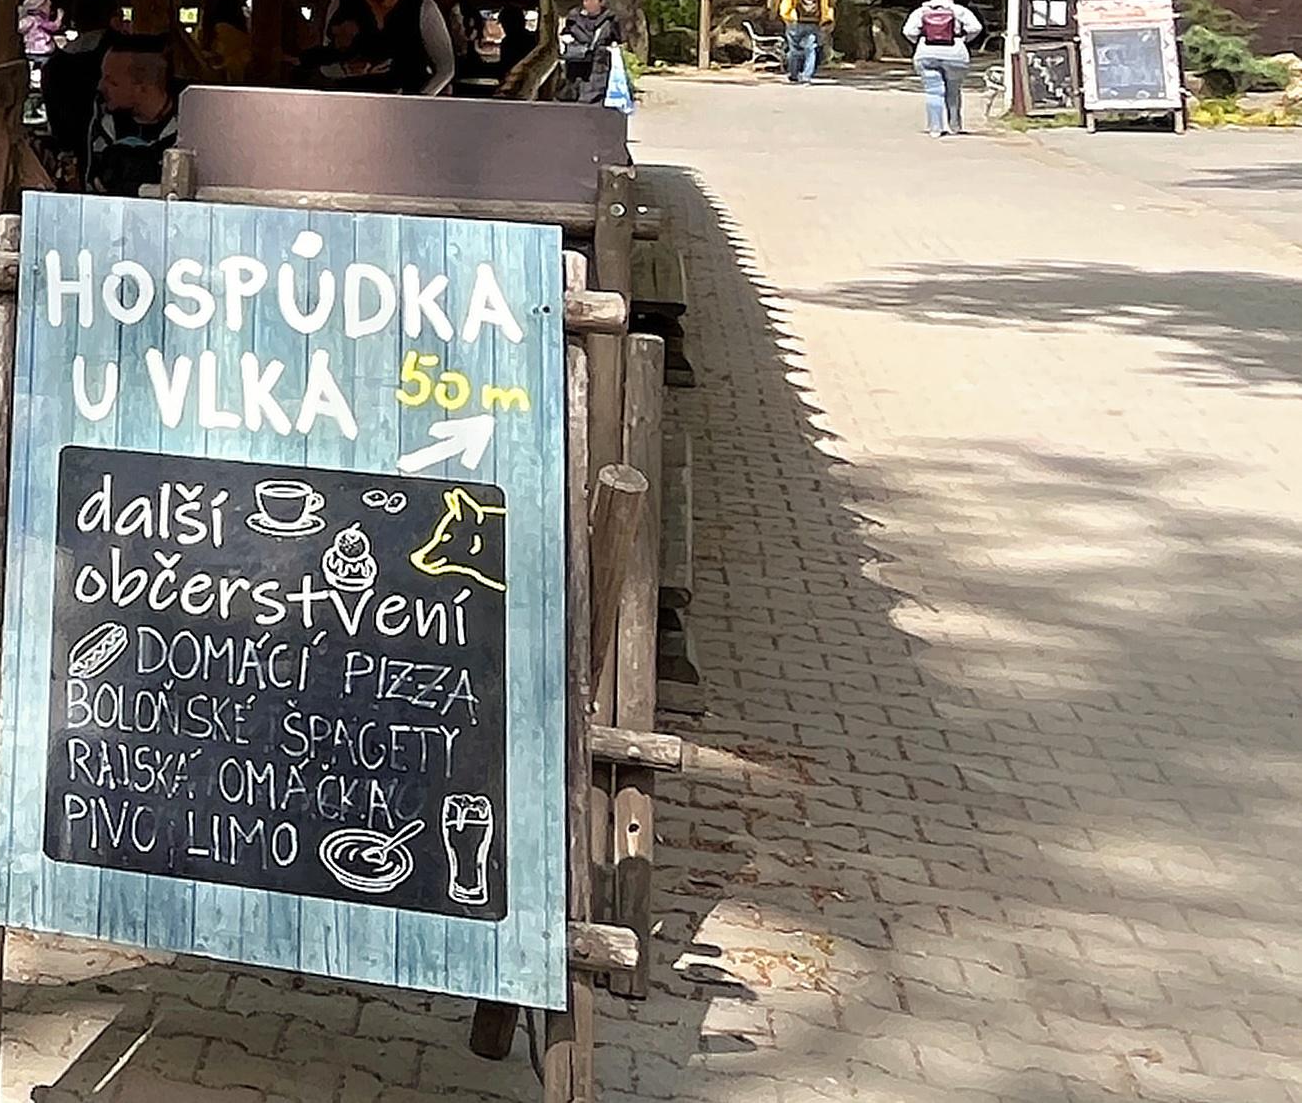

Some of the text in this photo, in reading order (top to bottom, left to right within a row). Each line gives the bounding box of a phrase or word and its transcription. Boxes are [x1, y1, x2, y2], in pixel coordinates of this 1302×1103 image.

[45, 230, 523, 343] HOSPŮDKA
[146, 348, 359, 441] VLKA
[395, 350, 530, 412] 50 m
[76, 473, 229, 548] další
[75, 547, 472, 646] občerstvení
[136, 626, 479, 725] DOMÁCÍ PIZZA
[66, 678, 460, 778] BOLOŇSKÉ ŠPAGETY
[67, 738, 394, 829] RAJSKÁ OMÁČKA
[64, 793, 298, 869] PIVO LIMO
